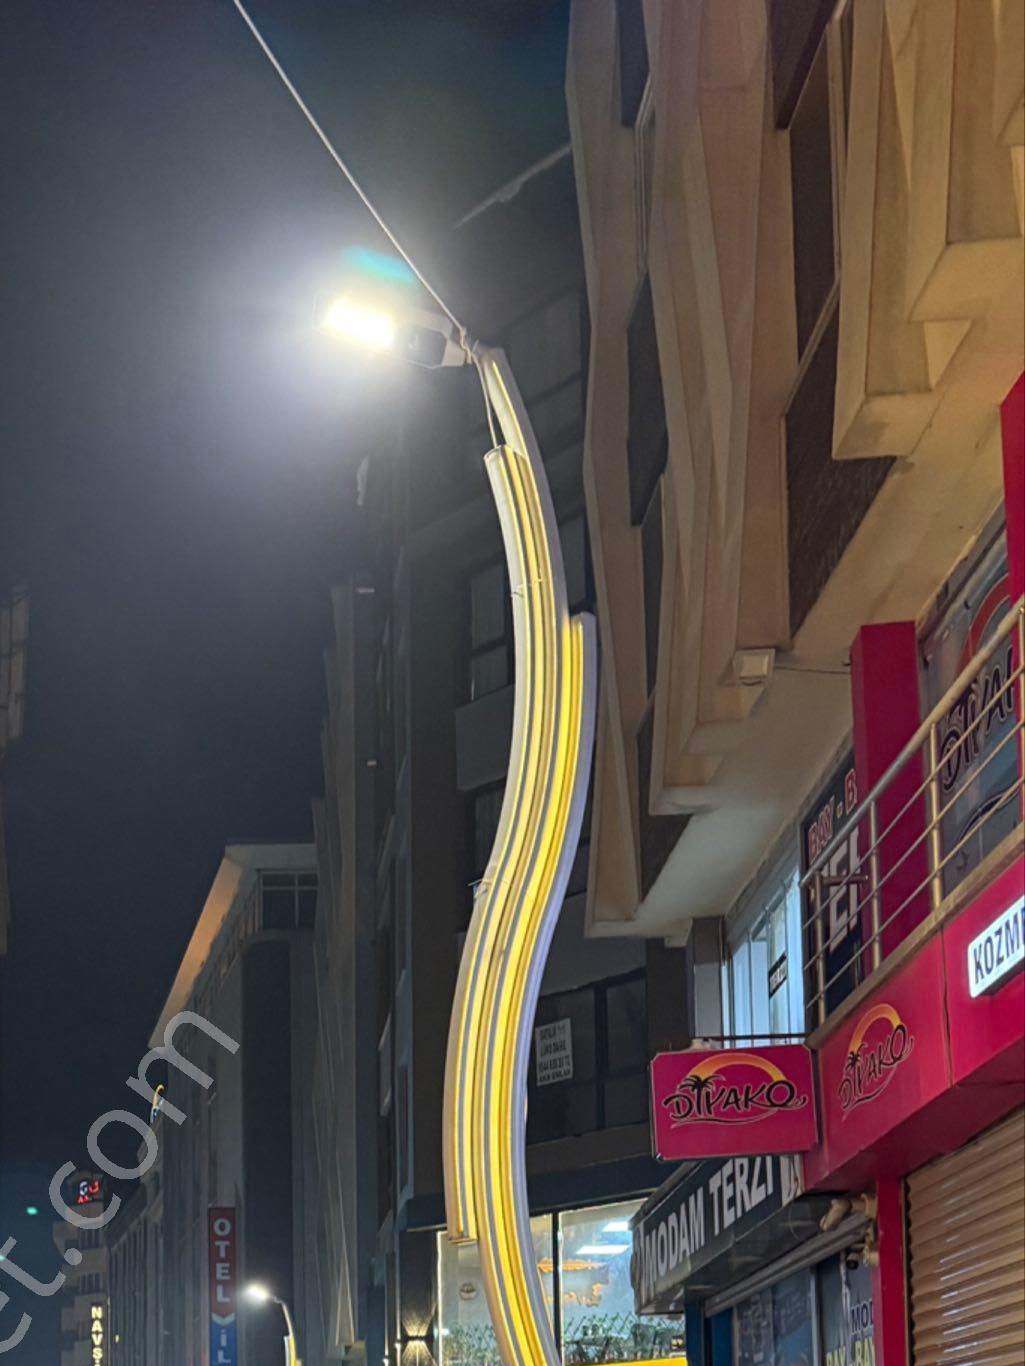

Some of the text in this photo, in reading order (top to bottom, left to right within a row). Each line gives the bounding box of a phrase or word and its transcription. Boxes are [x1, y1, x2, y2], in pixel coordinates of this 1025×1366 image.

[214, 1217, 232, 1303] OTEL
[639, 1187, 705, 1306] MODAM
[851, 1300, 873, 1334] MO
